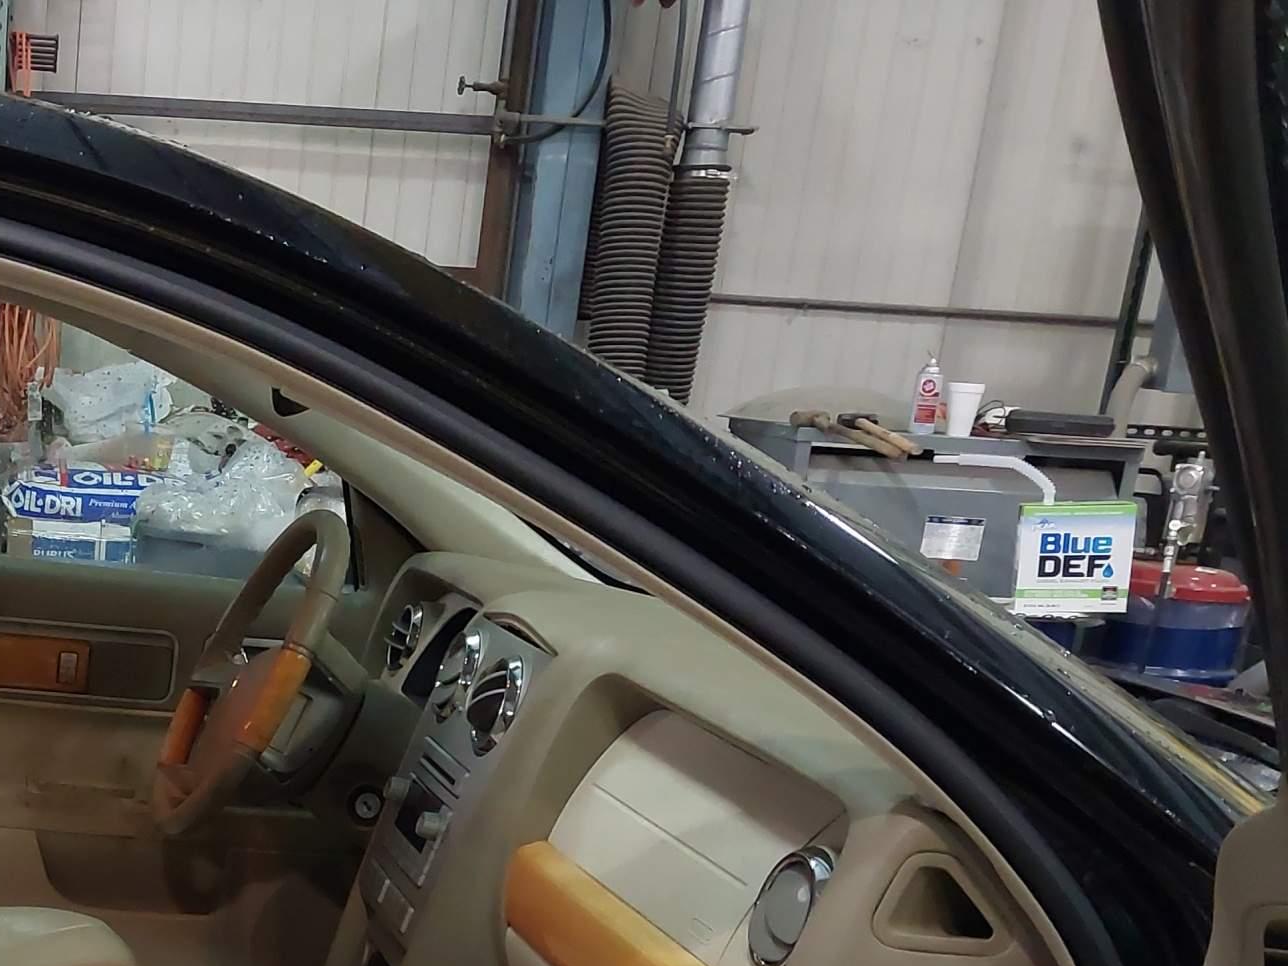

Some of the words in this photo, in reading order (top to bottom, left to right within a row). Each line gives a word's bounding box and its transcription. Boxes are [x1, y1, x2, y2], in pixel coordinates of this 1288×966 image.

[88, 498, 128, 509] Premium
[1039, 533, 1113, 554] Blue
[1037, 555, 1112, 578] DEF
